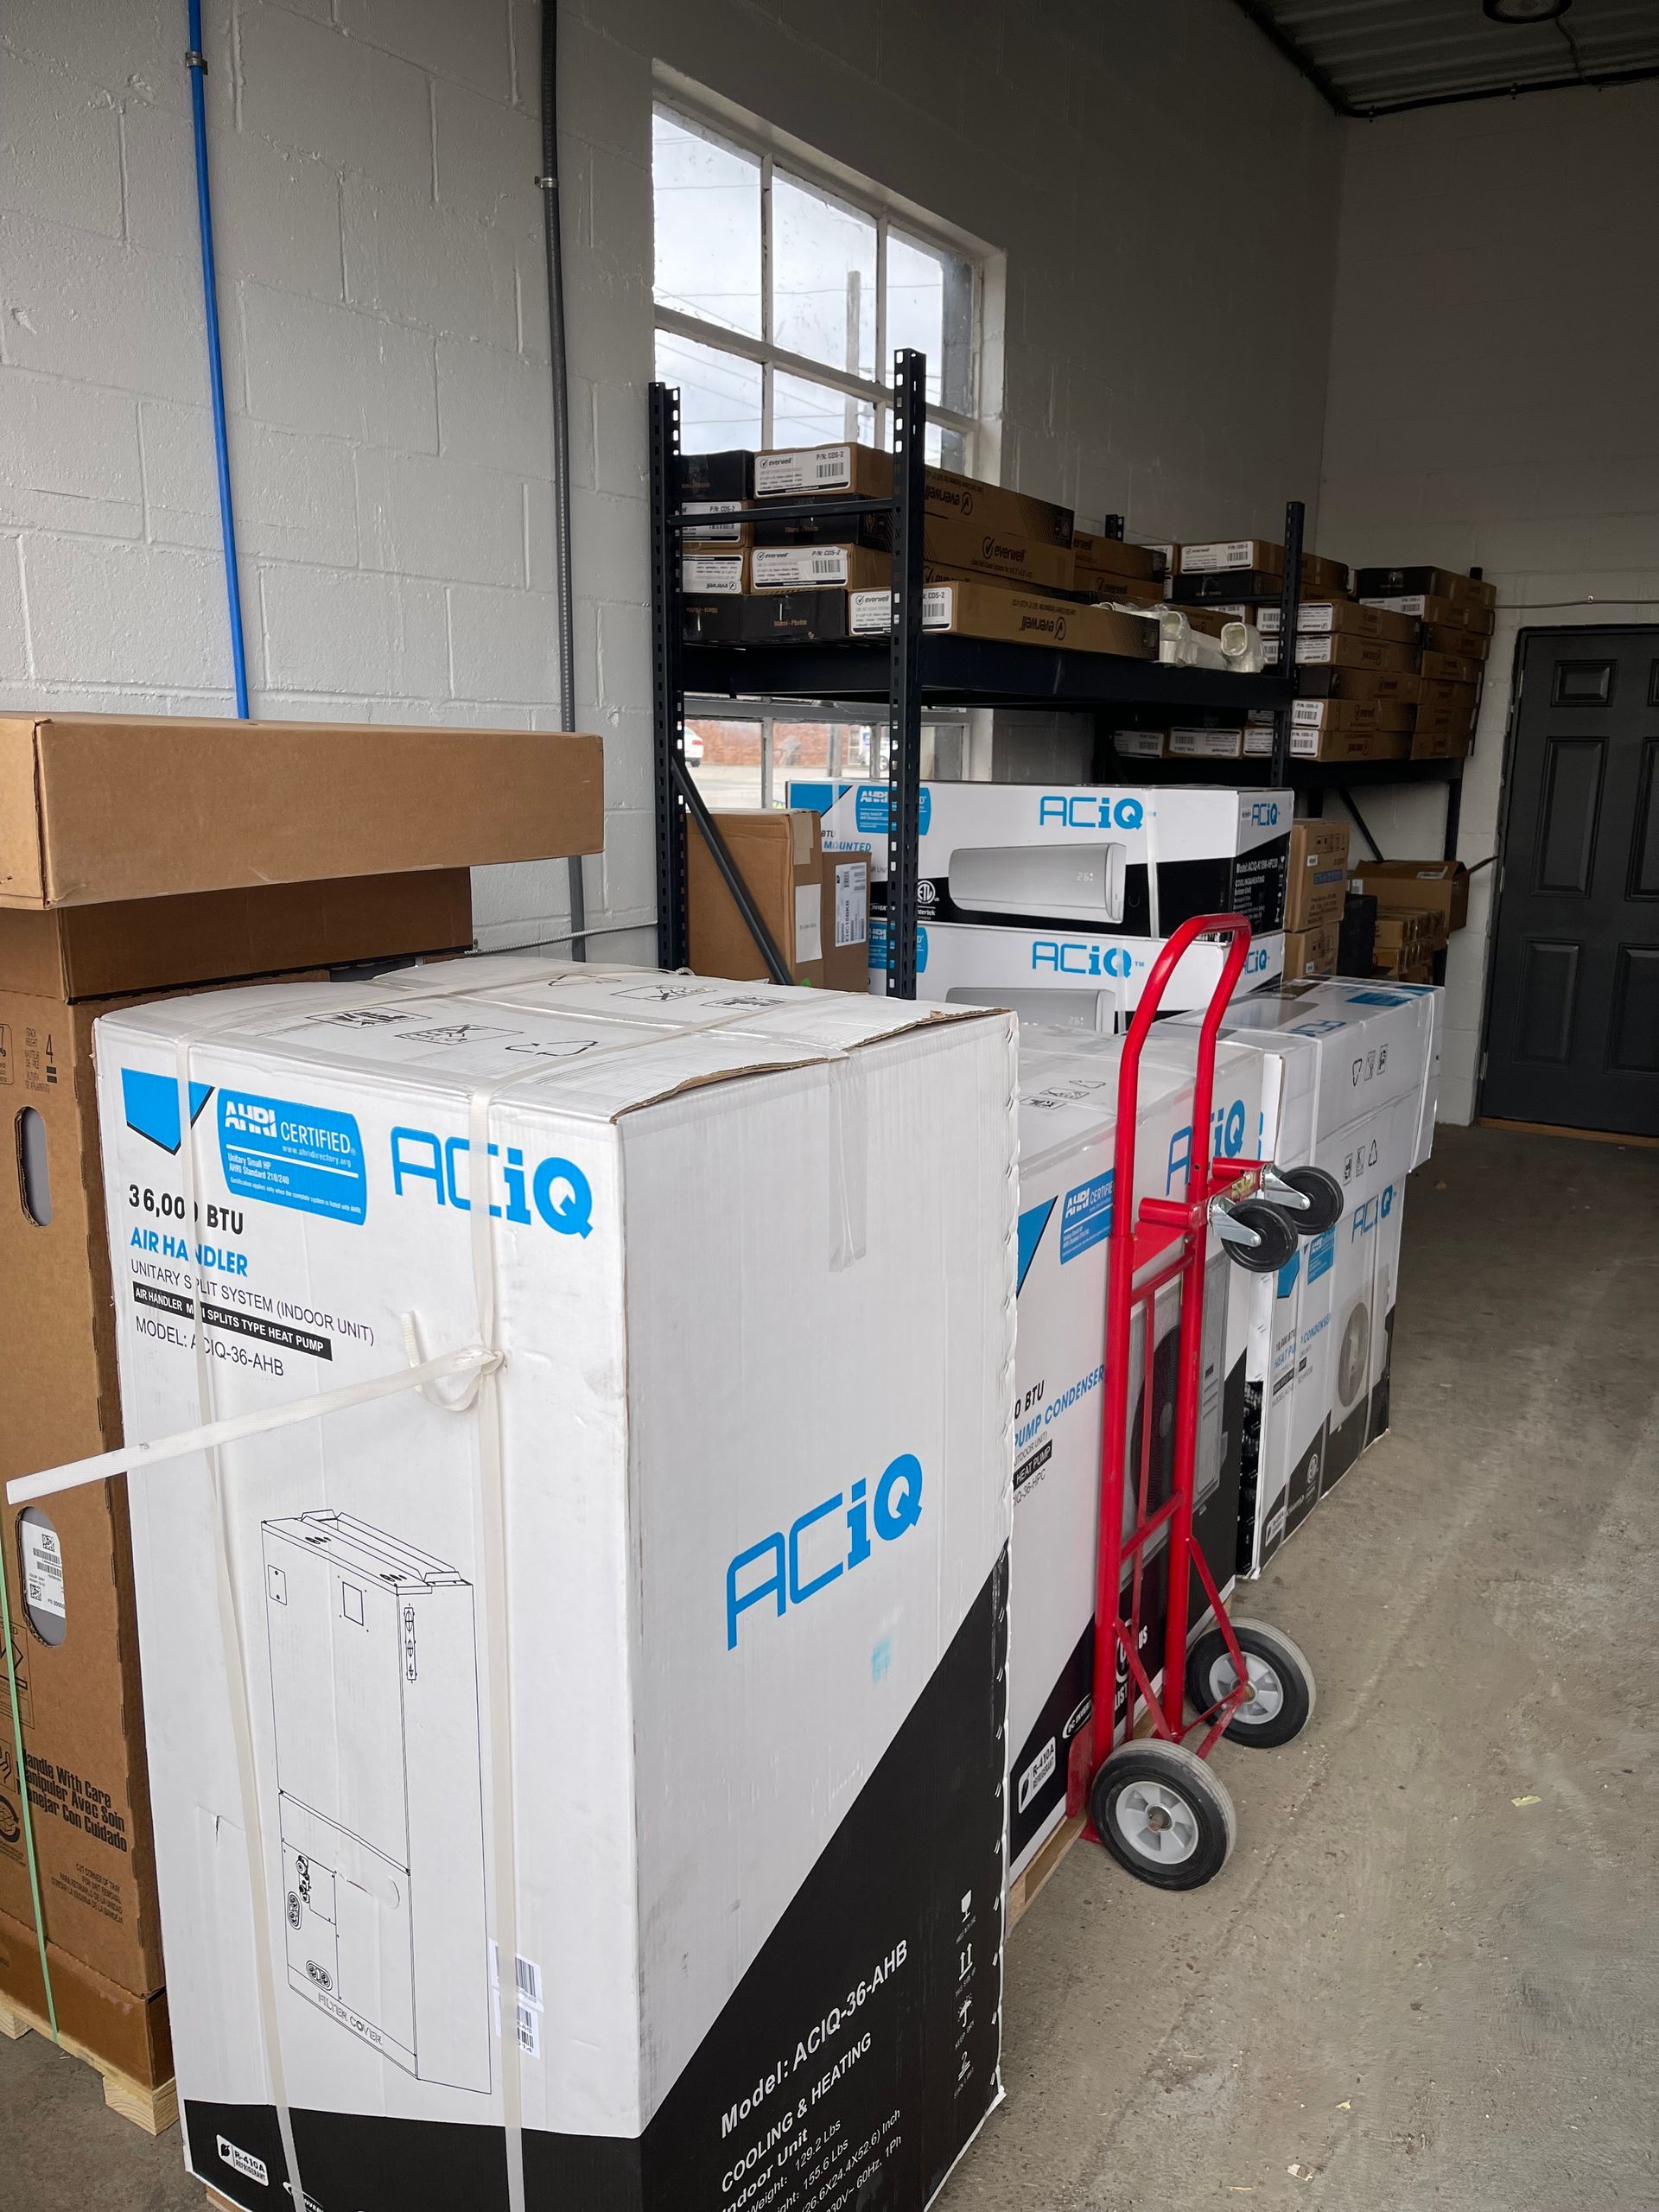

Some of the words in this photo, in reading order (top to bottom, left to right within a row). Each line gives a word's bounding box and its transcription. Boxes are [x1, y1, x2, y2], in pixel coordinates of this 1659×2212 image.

[768, 457, 793, 467] everwell
[828, 451, 844, 460] CDS-2
[995, 545, 1025, 563] everwell
[1021, 616, 1054, 632] everwell
[1039, 796, 1143, 830] ACiQ
[1032, 940, 1132, 978] ACiQ
[226, 1101, 277, 1139] AHRI
[281, 1121, 351, 1154] CERTIFIED
[228, 1153, 247, 1166] Unitary
[247, 1156, 263, 1168] Small
[390, 1126, 594, 1241] ACiQ
[1065, 1187, 1090, 1219] AHRI
[1090, 1180, 1114, 1205] CERTIFIE
[207, 1204, 244, 1235] BTU
[130, 1226, 159, 1254] AIR
[162, 1234, 248, 1278] HANDLER
[130, 1258, 181, 1287] UNITARY
[221, 1285, 273, 1313] SYSTEM
[276, 1300, 334, 1332] (INDOOR
[337, 1318, 374, 1347] UNIT)
[135, 1287, 148, 1300] AIR
[148, 1292, 183, 1312] HANDLER
[207, 1308, 239, 1328] SPLITS
[240, 1319, 266, 1336] TYPE
[268, 1326, 294, 1344] HEAT
[296, 1334, 324, 1352] PUMP
[136, 1315, 188, 1348] MODEL:
[1025, 1379, 1045, 1413] BTU
[1045, 1363, 1105, 1425] CONDENSER
[1015, 1460, 1033, 1486] HEAT
[1033, 1445, 1052, 1469] PUMP
[726, 1452, 923, 1652] ACiQ
[1033, 1744, 1054, 1777] R-410A
[56, 1765, 83, 1795] With
[85, 1780, 111, 1808] Care
[62, 1803, 82, 1829] Con
[85, 1815, 128, 1853] Cuidado
[71, 1790, 99, 1819] Avec
[101, 1805, 125, 1833] Soin
[318, 1992, 348, 2023] FILTER
[349, 2016, 383, 2046] COVER
[720, 2057, 789, 2139] Model:
[791, 1938, 908, 2072] ACIQ-36-AHB
[721, 2110, 794, 2194] COOLING
[797, 2097, 808, 2119] &
[810, 2031, 873, 2106] HEATING
[881, 2107, 901, 2135] Inch
[234, 2150, 265, 2174] R-410A
[777, 2127, 809, 2169] Unit
[795, 2139, 822, 2171] 129.2
[823, 2118, 842, 2149] Lbs
[803, 2159, 830, 2191] 155.6
[830, 2137, 849, 2167] Lbs
[855, 2160, 883, 2190] 60Hz,
[885, 2134, 902, 2159] 1Ph
